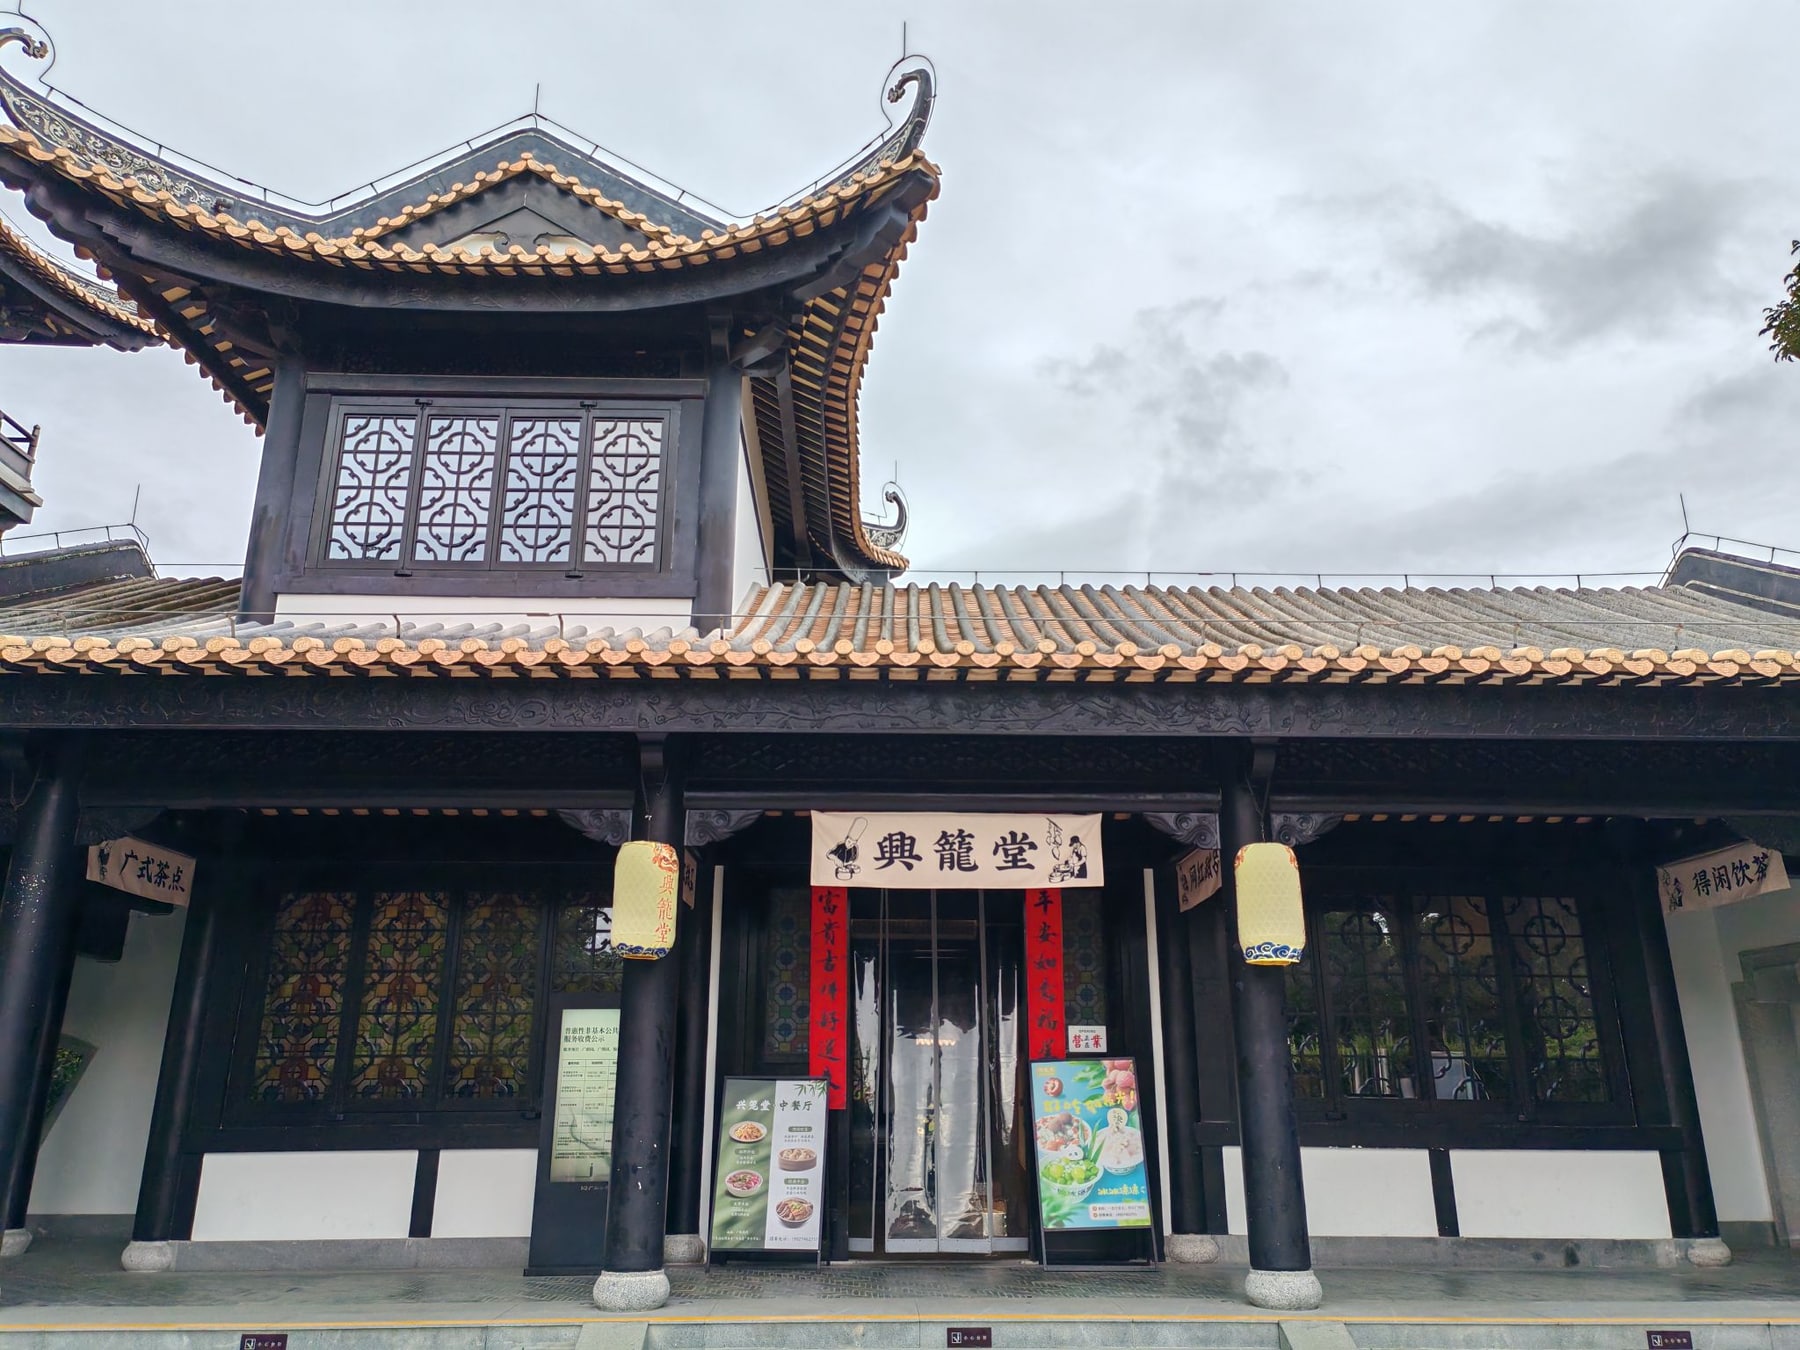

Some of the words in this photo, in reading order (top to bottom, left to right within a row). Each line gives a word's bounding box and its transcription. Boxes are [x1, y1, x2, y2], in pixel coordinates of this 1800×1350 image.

[120, 849, 185, 892] 广式茶点
[873, 828, 1038, 872] 興籠堂
[1693, 852, 1769, 897] 得闲饮茶
[655, 875, 674, 943] 興籠堂
